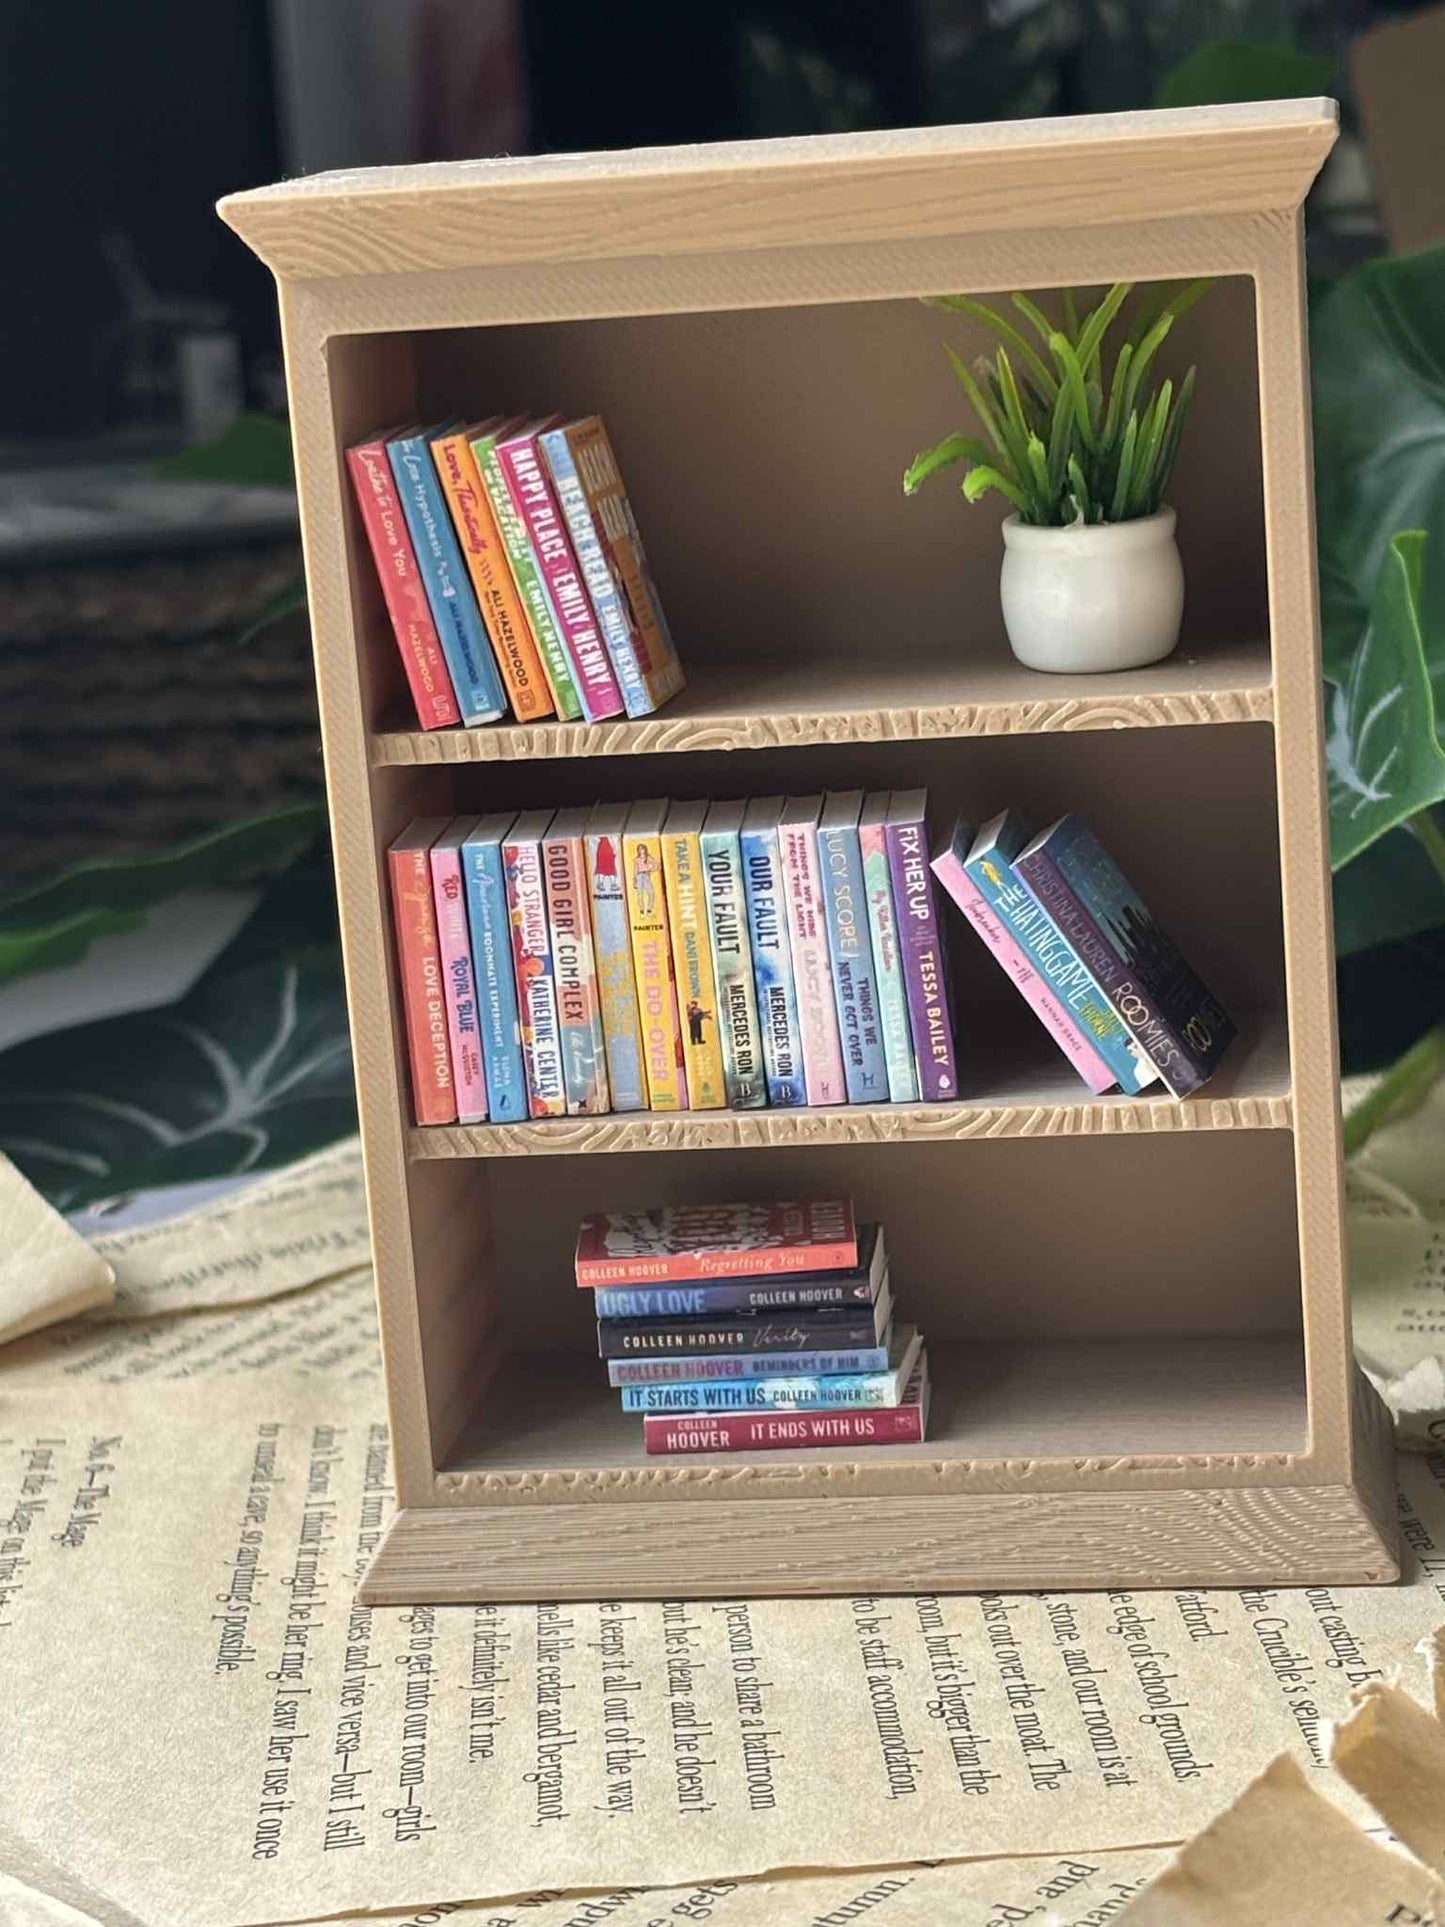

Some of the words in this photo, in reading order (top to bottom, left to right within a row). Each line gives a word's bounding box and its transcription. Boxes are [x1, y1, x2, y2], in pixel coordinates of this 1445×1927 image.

[444, 443, 461, 484] Love,
[414, 484, 442, 557] Hypothesis
[510, 448, 548, 504] HAPPY
[530, 507, 568, 562] PLACE
[380, 511, 398, 546] Love
[393, 548, 407, 577] You
[553, 572, 590, 625] EMILY
[497, 610, 528, 687] HAZELWOOD
[526, 579, 552, 629] EMILY
[542, 630, 570, 681] HENRY
[571, 629, 611, 685] HENRY
[615, 646, 642, 689] HENRY
[518, 846, 538, 885] HELLO
[547, 844, 571, 892] GOOD
[675, 839, 690, 871] TAKE
[788, 833, 799, 869] FROM
[797, 833, 810, 880] THINGS
[804, 885, 813, 903] WE
[826, 830, 848, 877] LUCY
[442, 874, 460, 899] RED
[708, 850, 733, 897] YOUR
[749, 856, 773, 892] OUR
[793, 875, 801, 897] THE
[902, 857, 927, 895] HER
[522, 890, 545, 955] STRANGER
[553, 898, 575, 938] GIRL
[678, 884, 698, 929] HINT
[754, 897, 780, 949] FAULT
[796, 904, 806, 938] LIGHT
[834, 885, 858, 949] SCORE
[909, 896, 929, 920] UP
[713, 902, 740, 954] FAULT
[1010, 899, 1064, 961] HATING
[422, 957, 438, 997] LOVE
[449, 956, 470, 998] ROYAL
[642, 940, 660, 979] THE
[918, 951, 938, 1004] TESSA
[1023, 853, 1077, 926] CHRISTINA
[1070, 923, 1120, 982] LAUREN
[1112, 982, 1180, 1067] ROOMIES
[557, 944, 584, 1021] COMPLEX
[857, 978, 874, 1022] THINGS
[456, 1000, 474, 1034] BLUE
[490, 990, 504, 1048] EXPERIMENT
[531, 978, 554, 1045] KATHERINE
[729, 984, 751, 1047] MERCEDES
[770, 987, 790, 1050] MERCEDES
[838, 961, 855, 1003] NEVER
[848, 1034, 863, 1066] OVER
[427, 1001, 449, 1088] DECEPTION
[646, 986, 670, 1080] DO-OVER
[864, 1025, 878, 1045] WE
[926, 1007, 949, 1066] BAILEY
[536, 1050, 560, 1098] CENTER
[736, 1050, 754, 1075] RON
[776, 1053, 793, 1077] RON
[582, 1266, 625, 1280] COLLEEN
[628, 1263, 669, 1277] HOOVER
[602, 1291, 649, 1314] UGLY
[656, 1288, 706, 1312] LOVE
[750, 1292, 796, 1305] COLLEEN
[799, 1288, 842, 1301] HOOVER
[623, 1335, 683, 1348] COLLEEN
[689, 1332, 744, 1346] HOOVER
[753, 1325, 811, 1347] Verity
[617, 1363, 681, 1381] COLLEEN
[684, 1360, 744, 1378] HOOVER
[752, 1358, 816, 1373] REMINDERS
[820, 1357, 833, 1369] OF
[630, 1390, 642, 1407] IT
[647, 1389, 699, 1407] STARTS
[703, 1389, 741, 1406] WITH
[746, 1387, 766, 1405] US
[773, 1389, 817, 1402] COLLEEN
[820, 1388, 861, 1401] HOOVER
[666, 1431, 730, 1449] HOOVER
[751, 1424, 765, 1440] IT
[769, 1421, 807, 1438] ENDS
[811, 1419, 850, 1437] WITH
[854, 1418, 875, 1435] US
[677, 1420, 718, 1430] COLLEEN
[1400, 1520, 1435, 1551] were
[215, 1547, 270, 1614] anything's
[280, 1560, 328, 1600] might
[288, 1600, 327, 1622] be
[711, 1603, 755, 1654] person
[855, 1616, 892, 1635] be
[1046, 1602, 1080, 1647] stone,
[1106, 1605, 1156, 1642] edge
[211, 1613, 257, 1676] possible.
[285, 1623, 325, 1649] her
[409, 1636, 439, 1651] to
[536, 1637, 575, 1663] like
[587, 1616, 637, 1657] keeps
[664, 1625, 702, 1655] he's
[859, 1637, 905, 1670] staff
[924, 1633, 963, 1659] but
[987, 1624, 1022, 1649] out
[1127, 1642, 1170, 1659] of
[1319, 1615, 1367, 1668] casting
[343, 1645, 382, 1673] and
[394, 1653, 439, 1677] get
[457, 1630, 511, 1697] definitely
[732, 1656, 763, 1672] to
[995, 1650, 1027, 1680] over
[1061, 1648, 1109, 1677] and
[1252, 1618, 1316, 1694] Crucible's
[340, 1674, 375, 1708] vice
[404, 1679, 439, 1710] into
[536, 1666, 576, 1705] cedar
[602, 1675, 642, 1694] all
[663, 1657, 705, 1698] clean;
[735, 1676, 774, 1715] share
[1005, 1682, 1046, 1710] the
[1071, 1678, 1104, 1705] our
[1134, 1660, 1190, 1711] school
[271, 1700, 300, 1731] saw
[469, 1696, 507, 1730] isn't
[536, 1708, 577, 1740] and
[603, 1697, 635, 1724] out
[671, 1701, 713, 1729] and
[926, 1681, 976, 1731] bigger
[402, 1713, 427, 1741] our
[604, 1727, 646, 1745] of
[673, 1731, 713, 1752] he
[867, 1675, 925, 1800] accommodation,
[1013, 1712, 1055, 1757] moat.
[1081, 1708, 1119, 1752] room
[267, 1733, 310, 1762] her
[468, 1733, 494, 1764] me.
[606, 1749, 647, 1776] the
[949, 1733, 991, 1767] than
[1138, 1712, 1214, 1783] grounds.
[261, 1767, 290, 1797] use
[522, 1740, 577, 1828] bergamot,
[675, 1755, 717, 1814] doesn't
[742, 1730, 786, 1811] bathroom
[958, 1768, 1002, 1797] the
[1028, 1758, 1073, 1791] The
[1103, 1771, 1138, 1788] at
[592, 1779, 634, 1819] way.
[252, 1818, 283, 1861] once
[323, 1818, 366, 1852] still
[670, 1878, 738, 1920] gets
[1034, 1859, 1101, 1900] and
